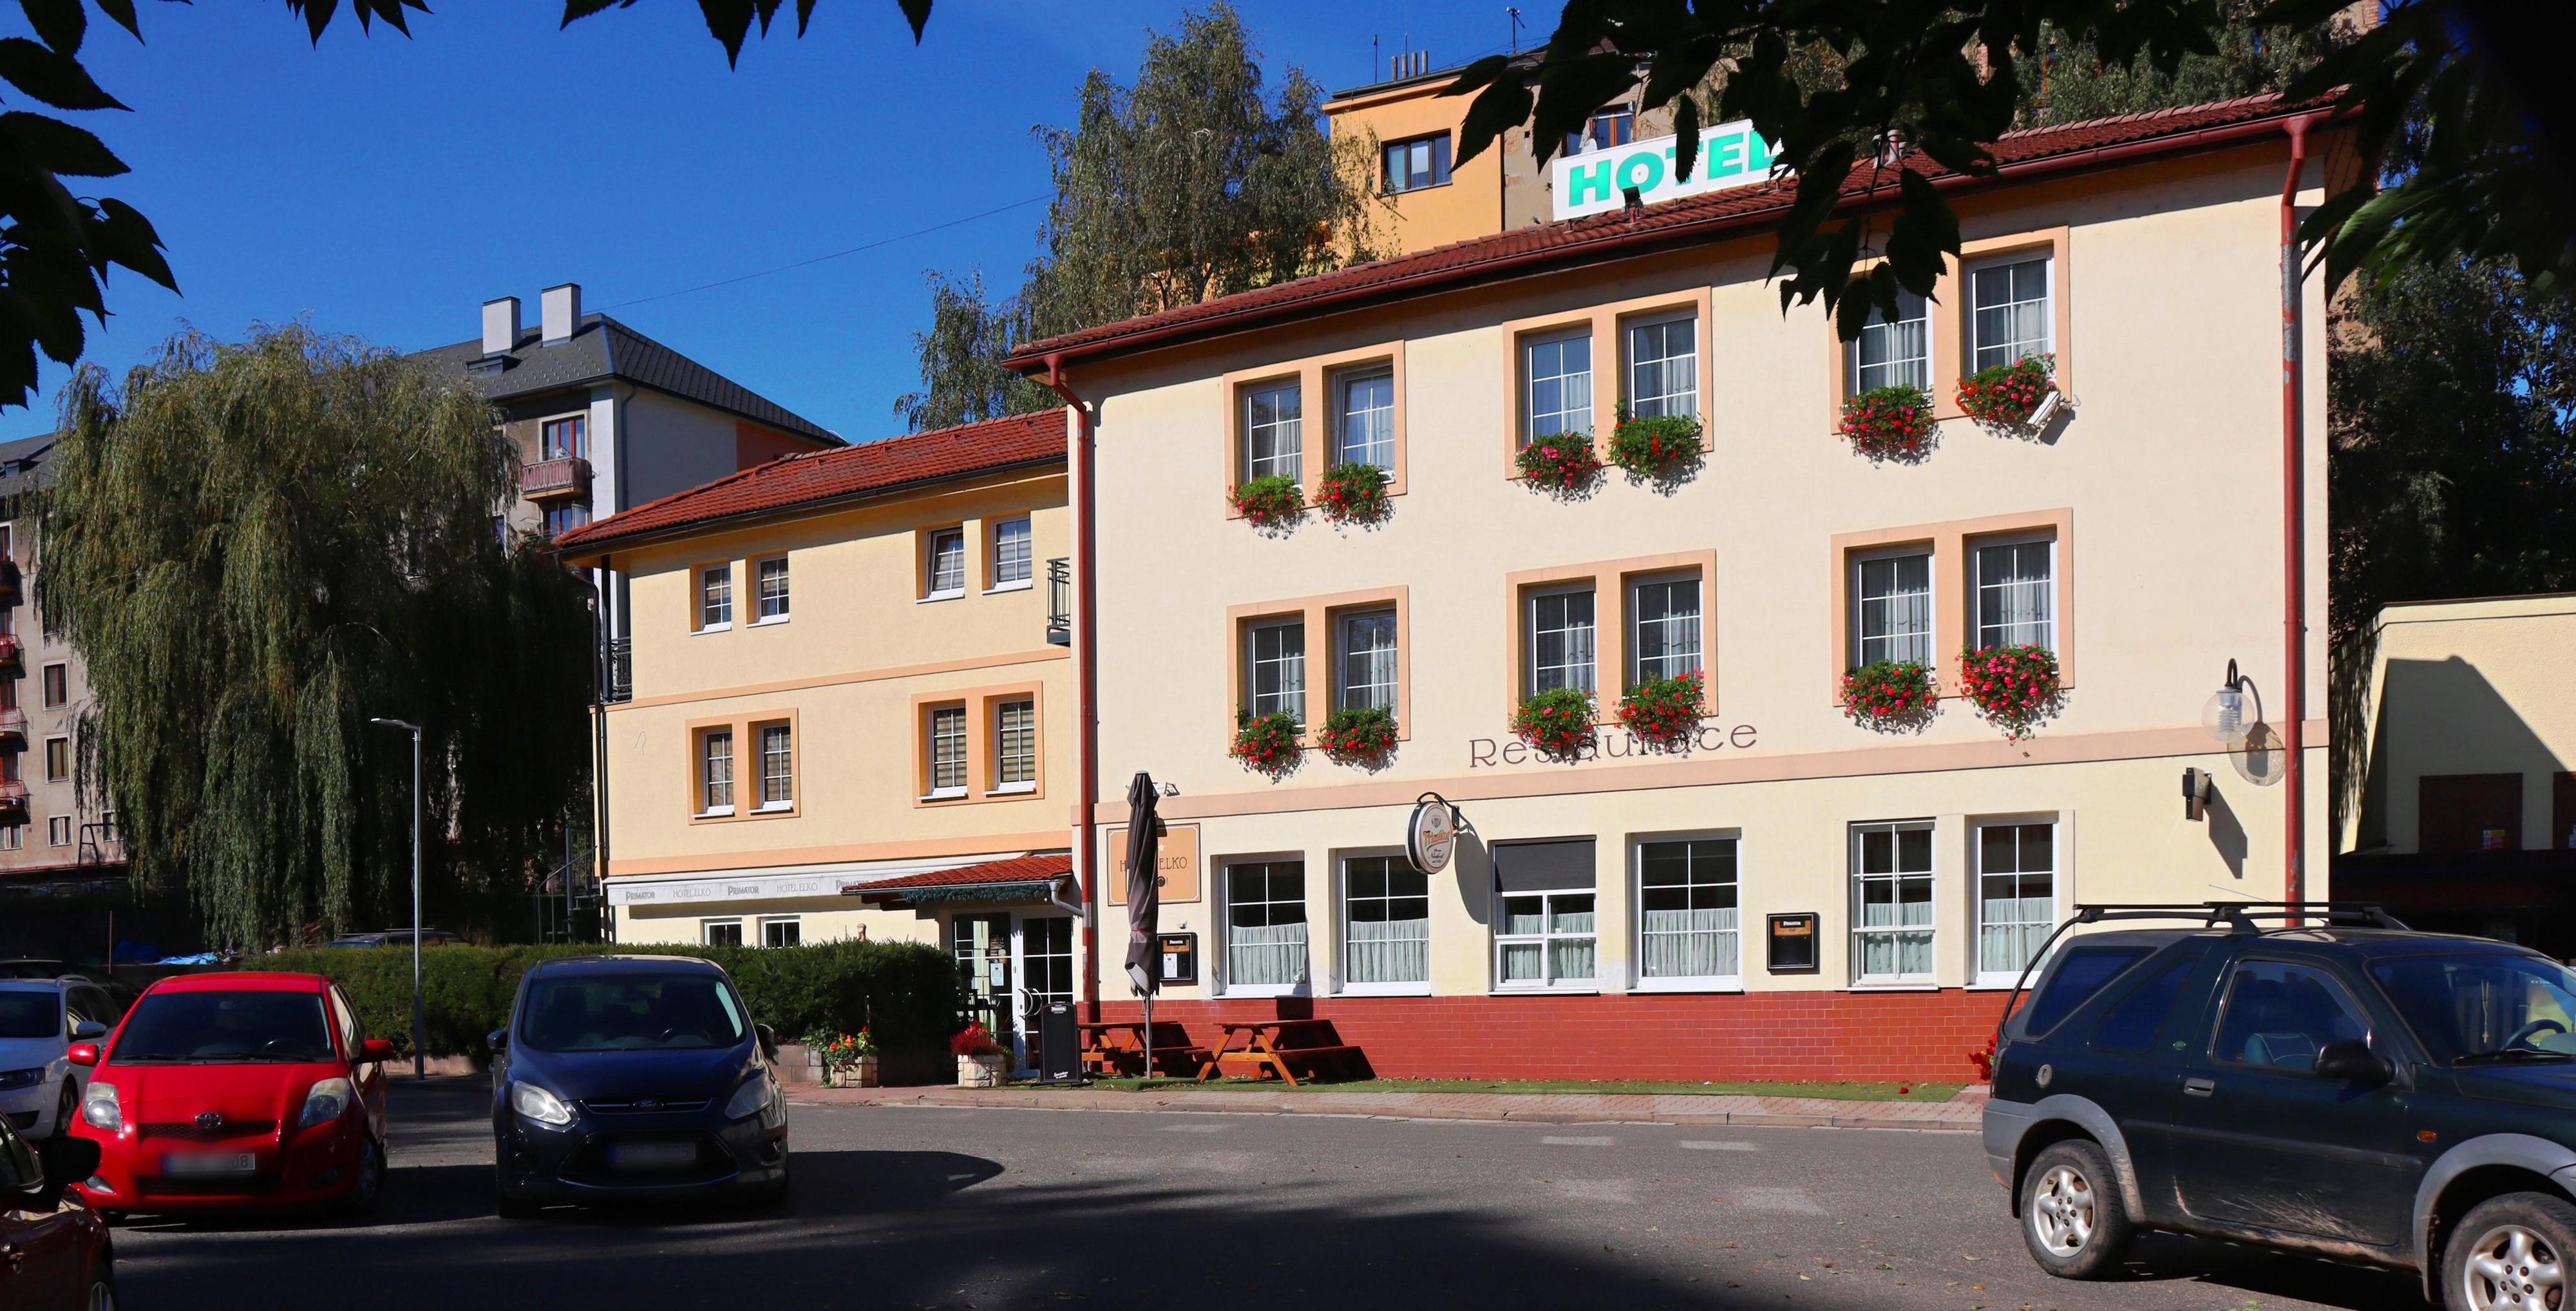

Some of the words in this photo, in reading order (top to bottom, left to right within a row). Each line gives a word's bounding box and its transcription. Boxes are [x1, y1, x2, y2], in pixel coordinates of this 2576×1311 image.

[1569, 130, 1777, 207] HOEL
[1159, 856, 1188, 870] ELKO
[625, 891, 656, 901] PRIMATOR
[673, 888, 694, 898] HOTEL
[694, 888, 712, 897] ELKO
[728, 885, 759, 896] PRIMATOR
[777, 883, 798, 894] HOTEL
[799, 882, 818, 892] ELKO
